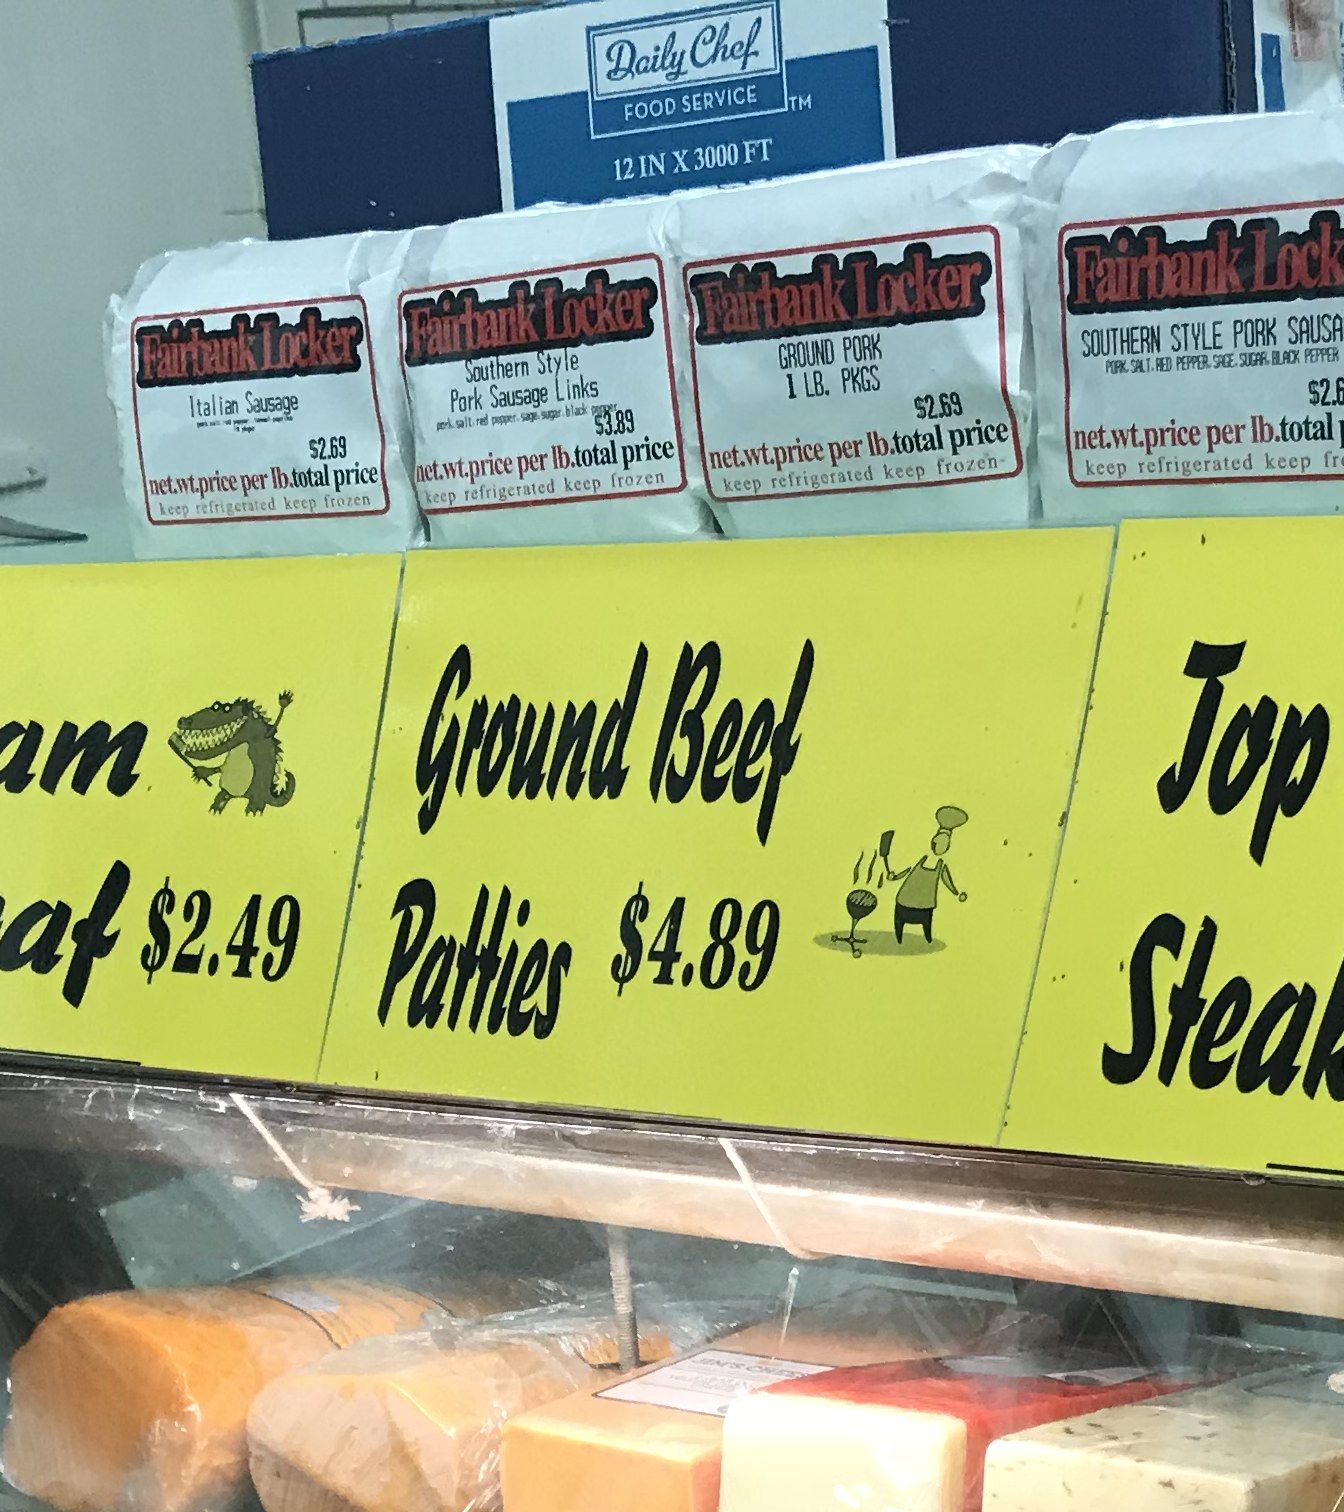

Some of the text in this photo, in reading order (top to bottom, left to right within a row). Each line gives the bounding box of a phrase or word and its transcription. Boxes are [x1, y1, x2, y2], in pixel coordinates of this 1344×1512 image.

[606, 16, 762, 82] Daily Chef
[624, 85, 757, 121] FOOD SERVICE
[788, 94, 811, 111] TM
[614, 138, 772, 181] 12 IN X 3000 FT
[1067, 221, 1243, 313] Fairbank
[692, 244, 990, 343] Fairbank Locker
[406, 271, 656, 365] Fairbank Locker
[1081, 326, 1161, 358] SOUTHERN
[1171, 320, 1223, 351] STYLE
[1233, 317, 1277, 348] PORK
[138, 309, 361, 386] Fairbank Locker
[465, 348, 579, 382] Southern Style
[778, 334, 882, 370] GROUND PORK
[450, 375, 599, 412] Pork Sausage Links
[786, 366, 881, 399] 1 LB. PKGS
[190, 391, 298, 418] Italian Sausage
[595, 410, 636, 436] $3.89
[914, 392, 963, 420] $2.69
[309, 436, 347, 459] $2.69
[416, 639, 814, 846] Ground Beef
[1156, 639, 1331, 865] Top
[140, 878, 301, 984] $2.49
[378, 878, 780, 1039] Patties $4.89
